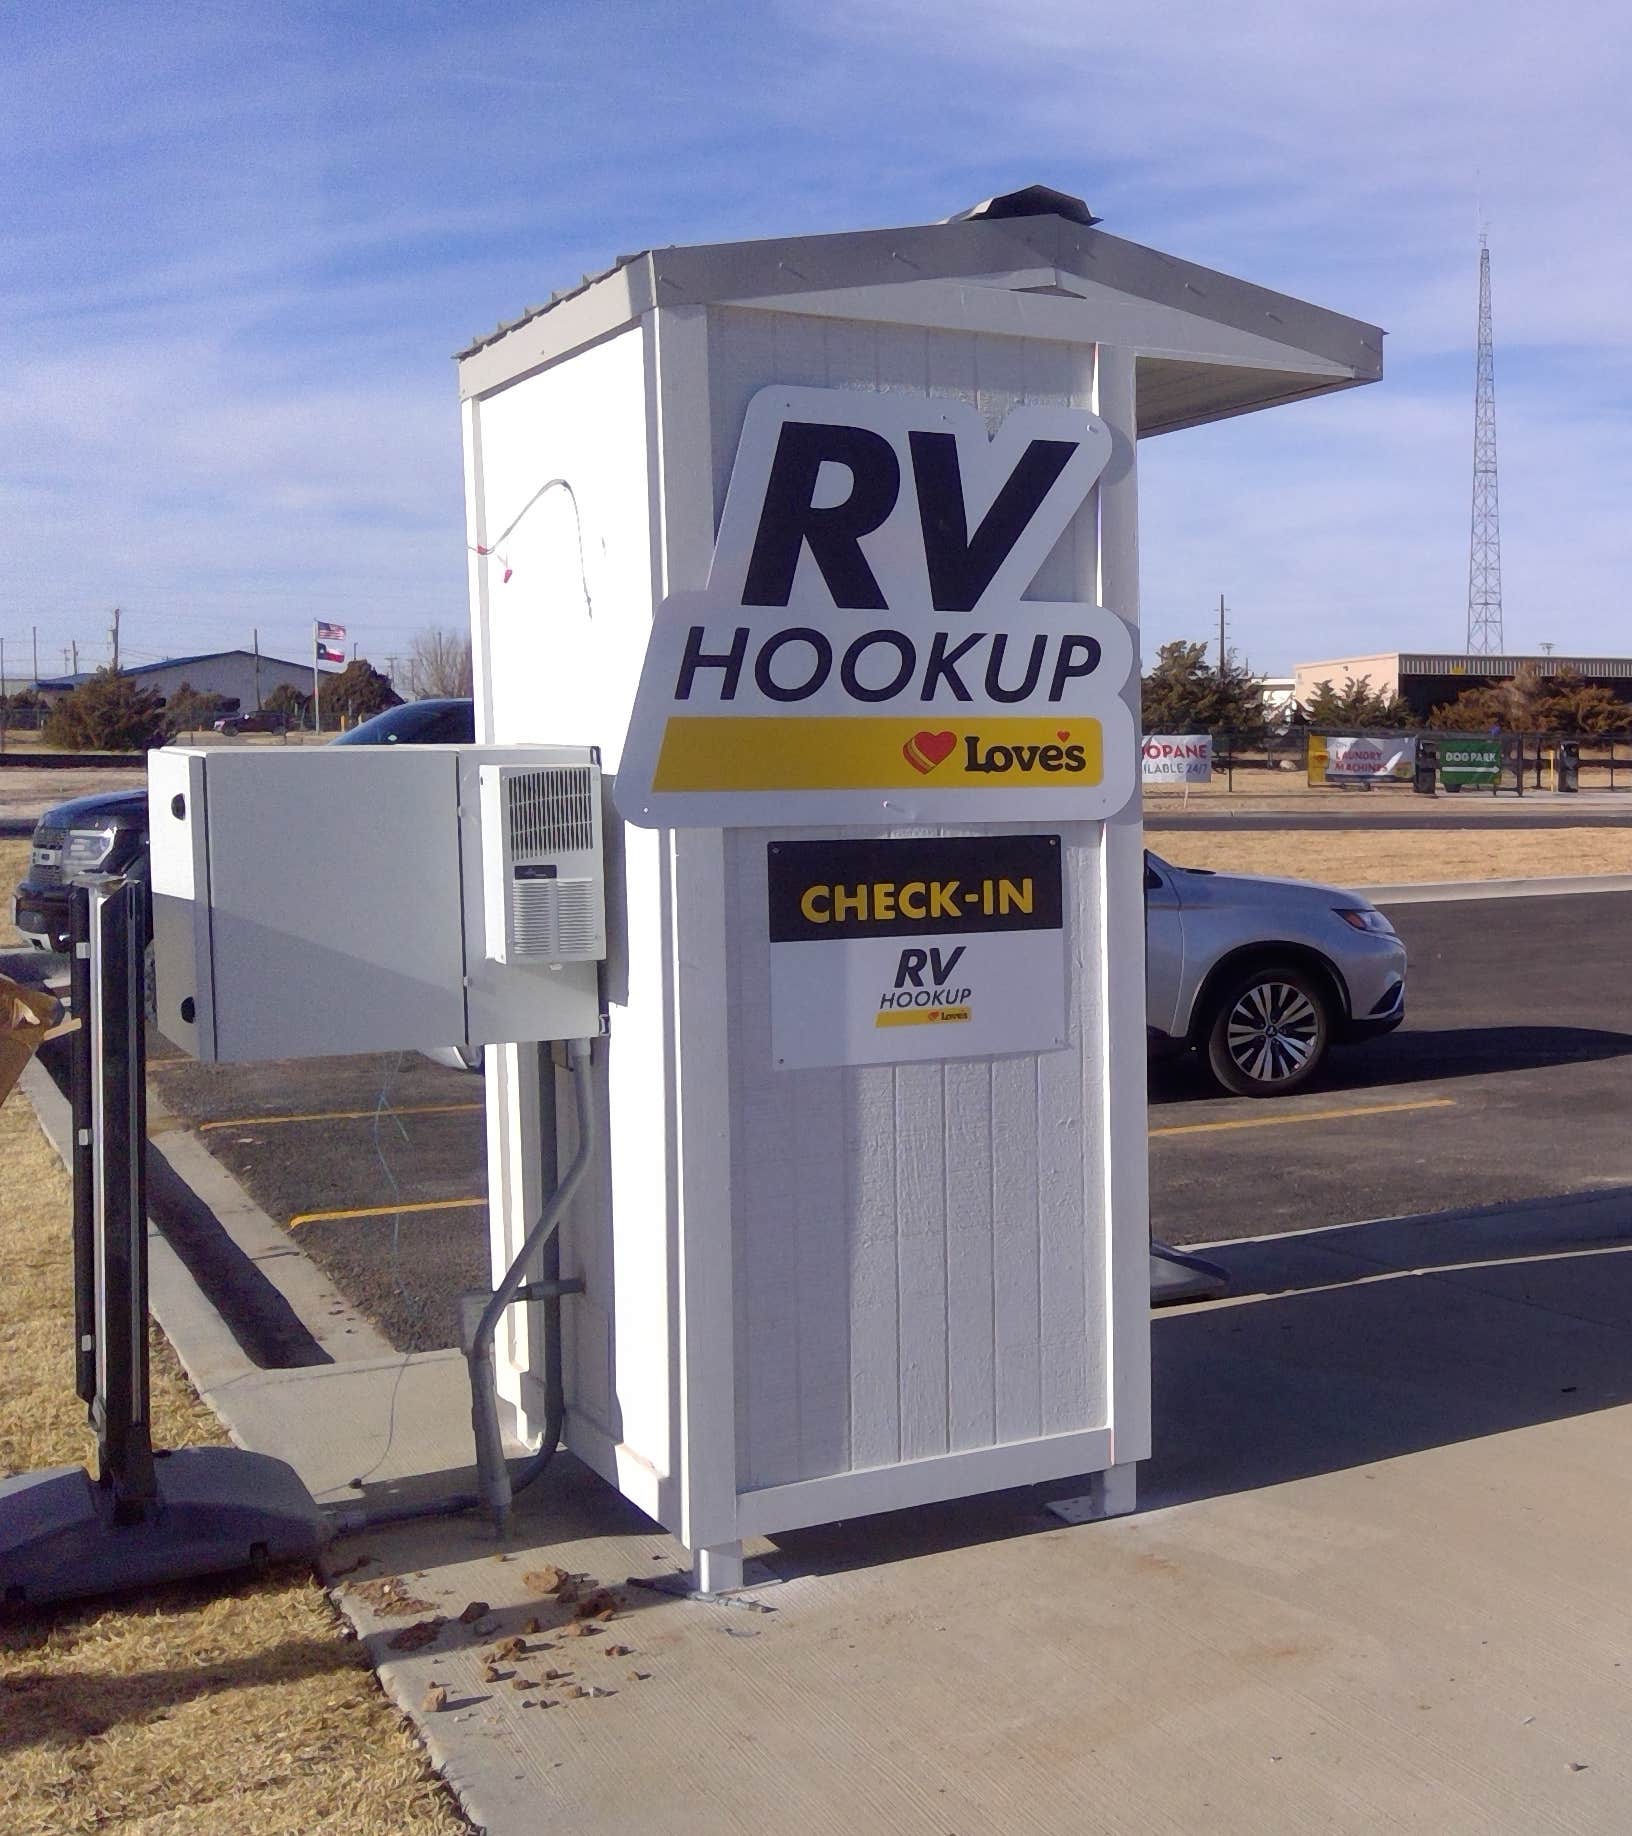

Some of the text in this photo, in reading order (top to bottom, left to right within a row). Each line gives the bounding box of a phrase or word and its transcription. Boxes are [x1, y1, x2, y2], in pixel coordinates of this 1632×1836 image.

[741, 421, 1080, 612] RV
[674, 626, 1101, 702] HOOKUP
[1445, 751, 1497, 762] DOG PARK
[801, 878, 1033, 923] CHECK-IN
[894, 946, 967, 988] RV
[880, 988, 972, 1009] HOOKUP
